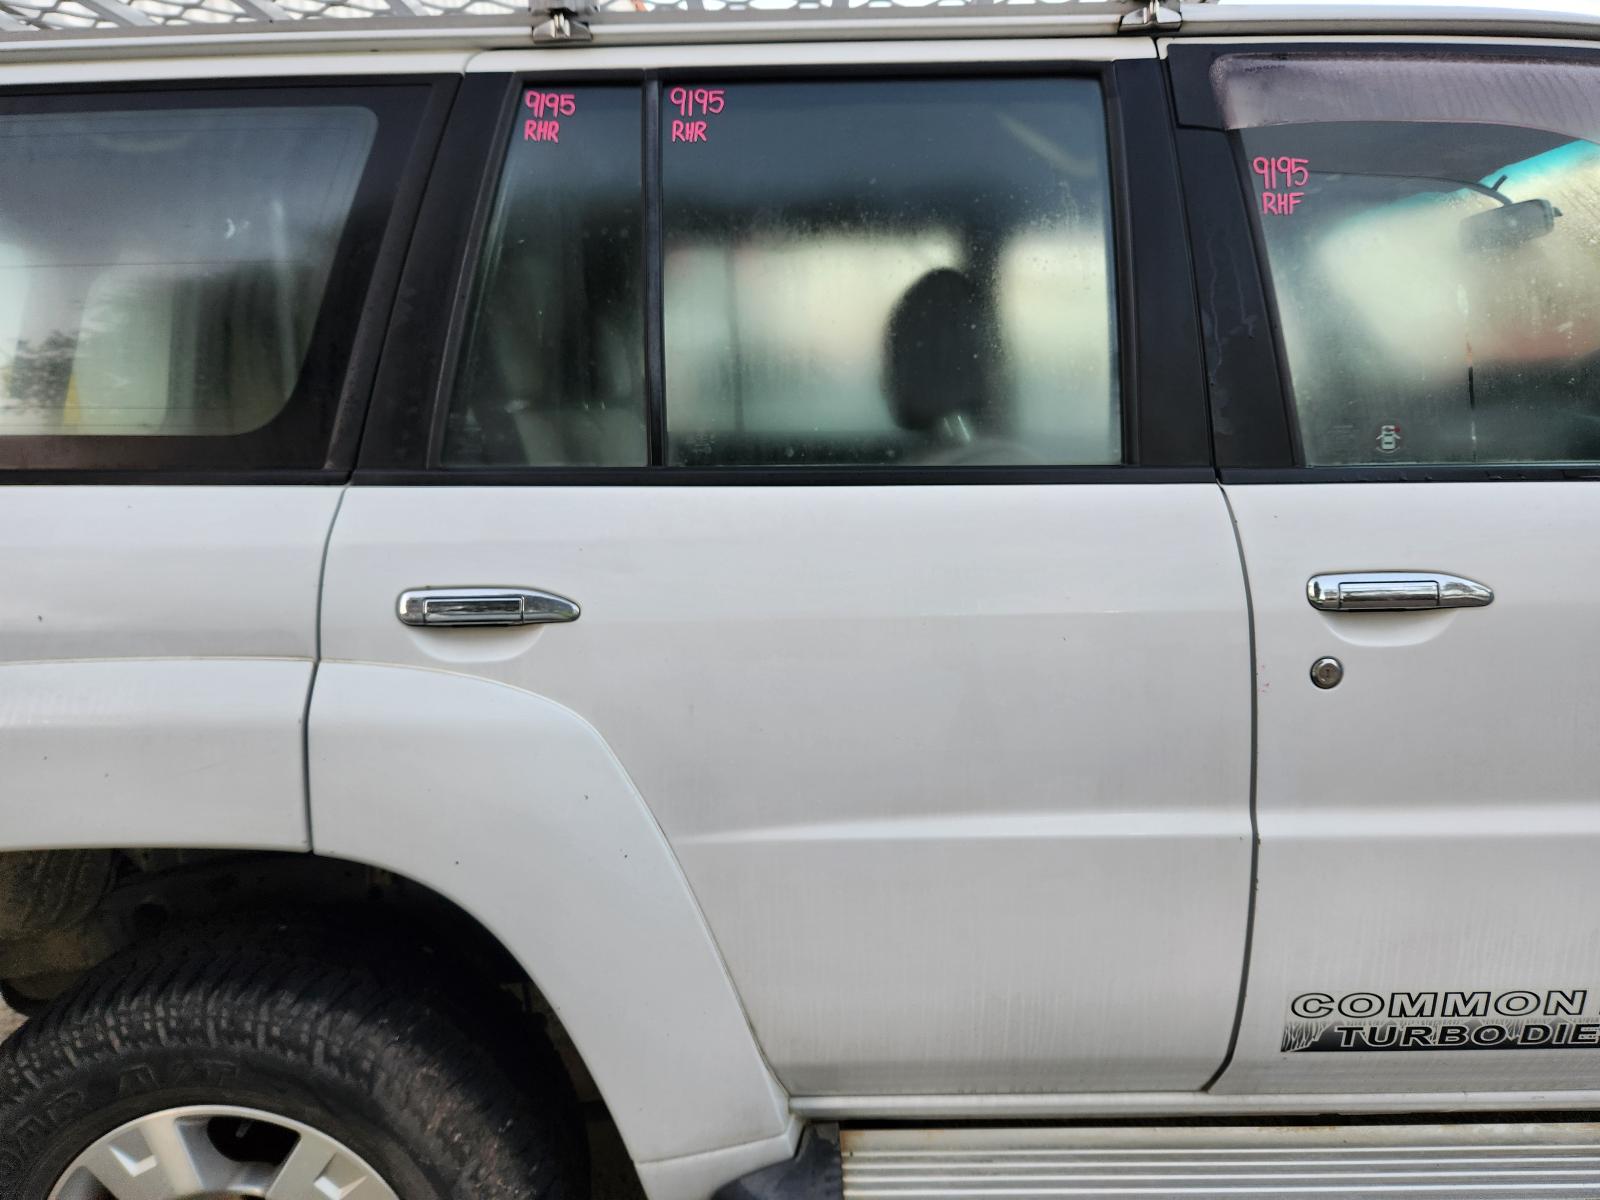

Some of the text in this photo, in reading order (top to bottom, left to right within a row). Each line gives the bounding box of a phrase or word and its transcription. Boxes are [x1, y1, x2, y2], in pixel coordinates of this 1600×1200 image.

[524, 90, 577, 118] 9195
[670, 86, 726, 117] 9195
[524, 119, 560, 144] RHR
[671, 119, 708, 144] RHR
[1252, 156, 1310, 190] 9195
[1261, 191, 1305, 216] RHF
[1290, 989, 1588, 1019] COMMON
[1334, 1022, 1600, 1048] TURBO DIE
